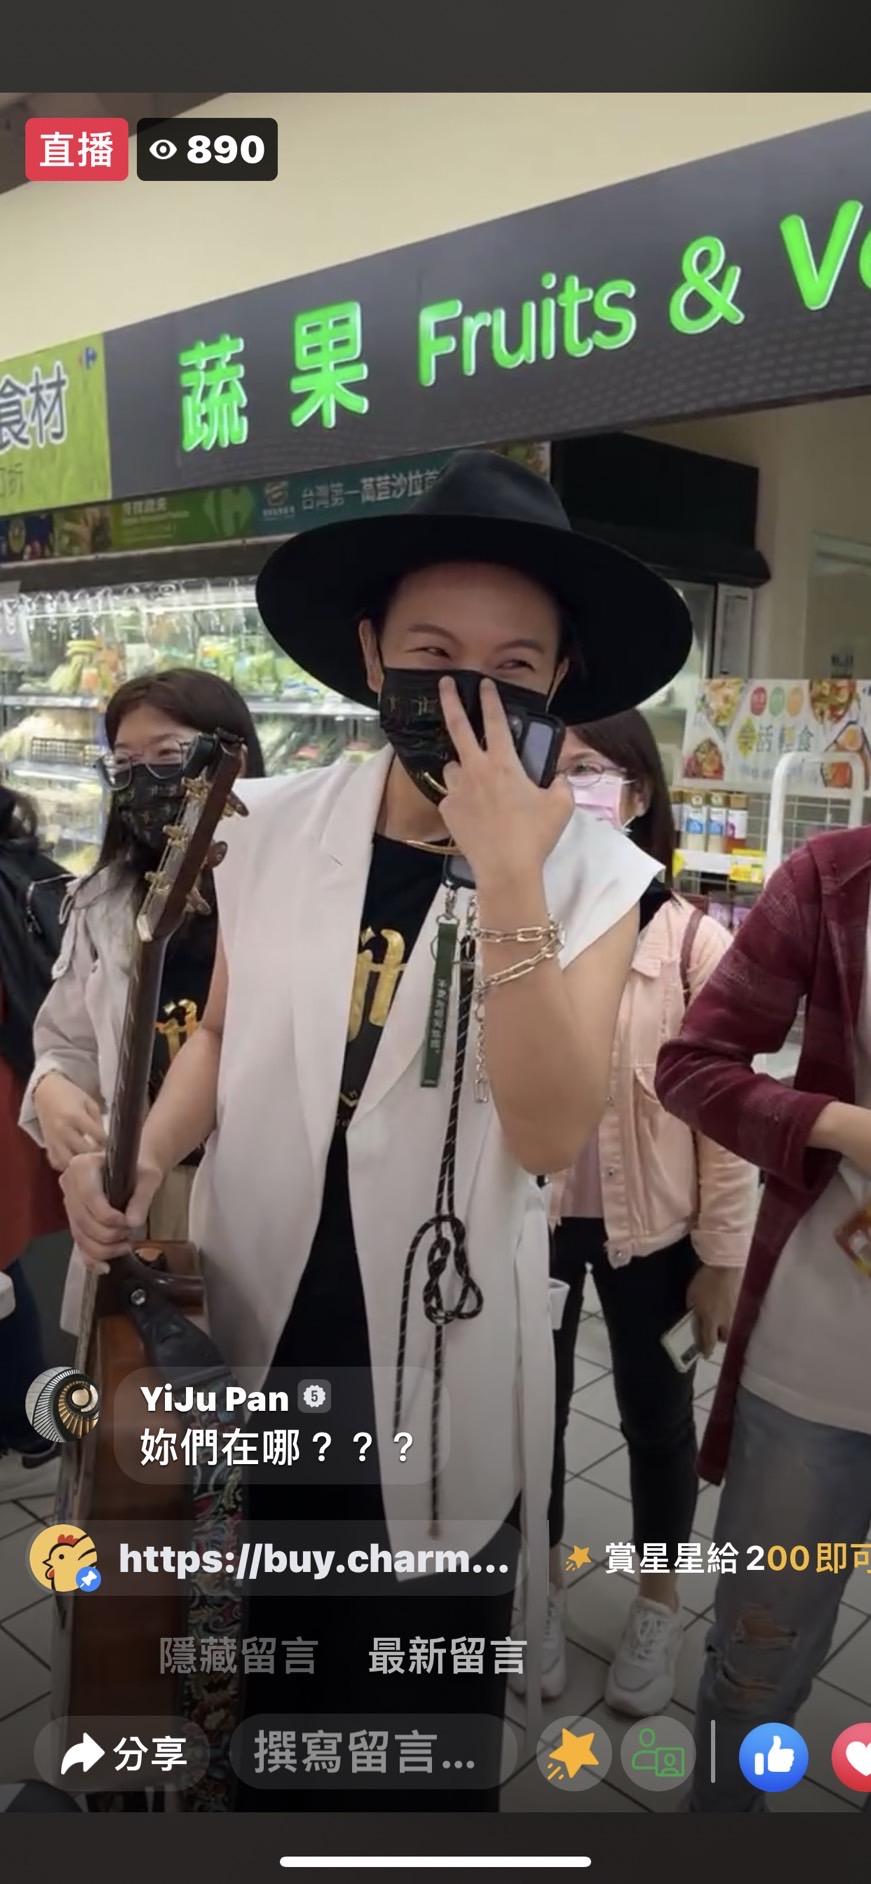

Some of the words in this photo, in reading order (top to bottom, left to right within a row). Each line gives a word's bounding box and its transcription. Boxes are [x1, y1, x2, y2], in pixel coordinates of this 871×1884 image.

[419, 273, 636, 386] Fruits
[669, 236, 745, 334] &
[780, 200, 871, 310] V
